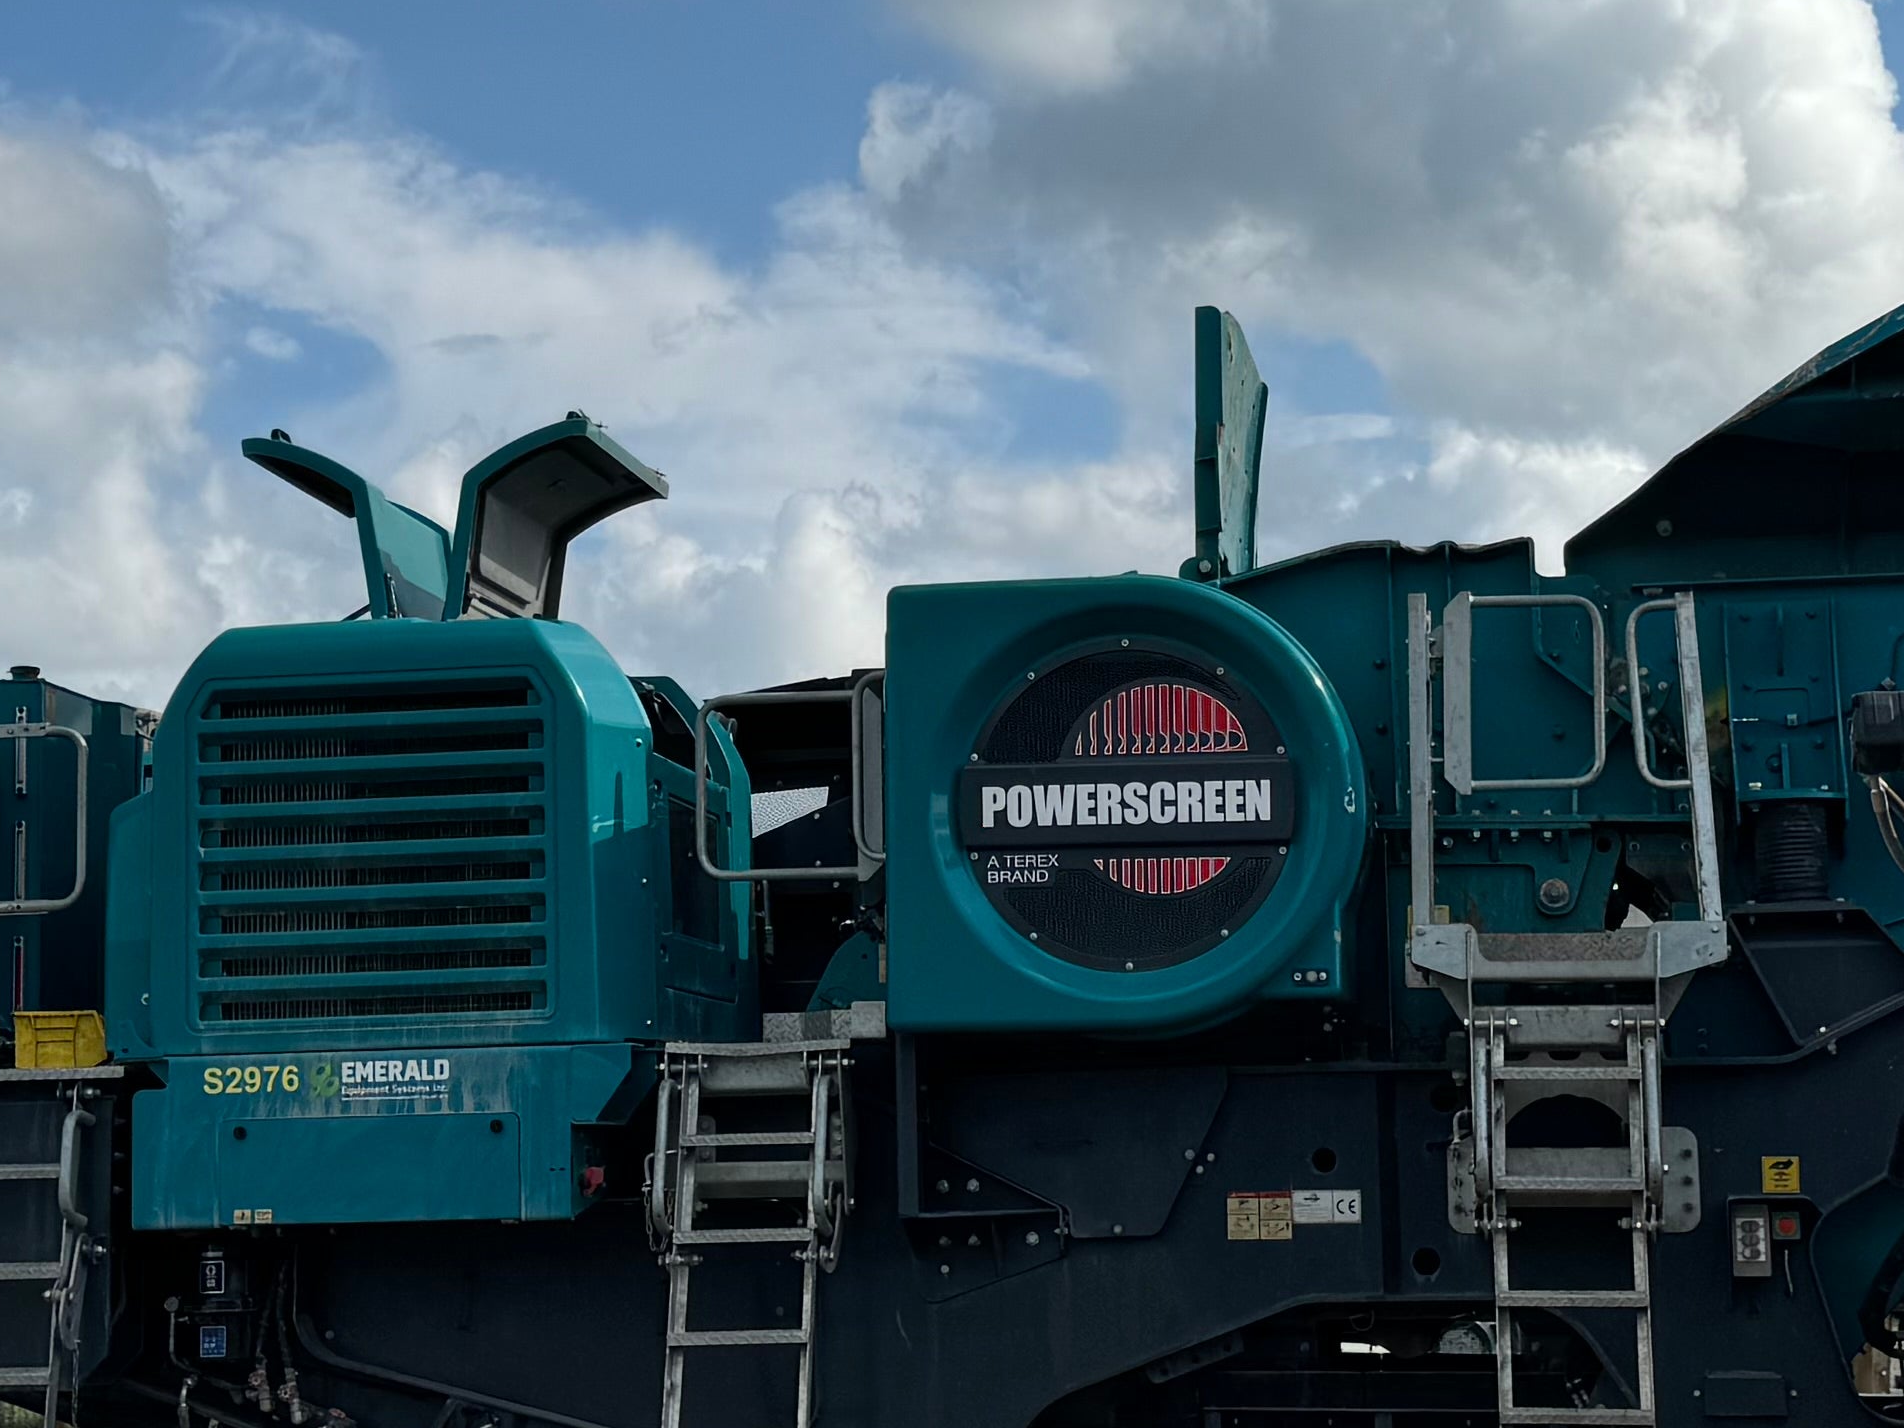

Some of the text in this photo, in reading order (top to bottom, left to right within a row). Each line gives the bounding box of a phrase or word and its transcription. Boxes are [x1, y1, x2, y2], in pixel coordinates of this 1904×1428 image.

[981, 779, 1271, 828] POWERSCREEN
[987, 854, 1059, 869] A TEREX
[987, 869, 1049, 883] BRAND
[203, 1065, 299, 1095] S2976
[341, 1059, 450, 1083] EMERALD
